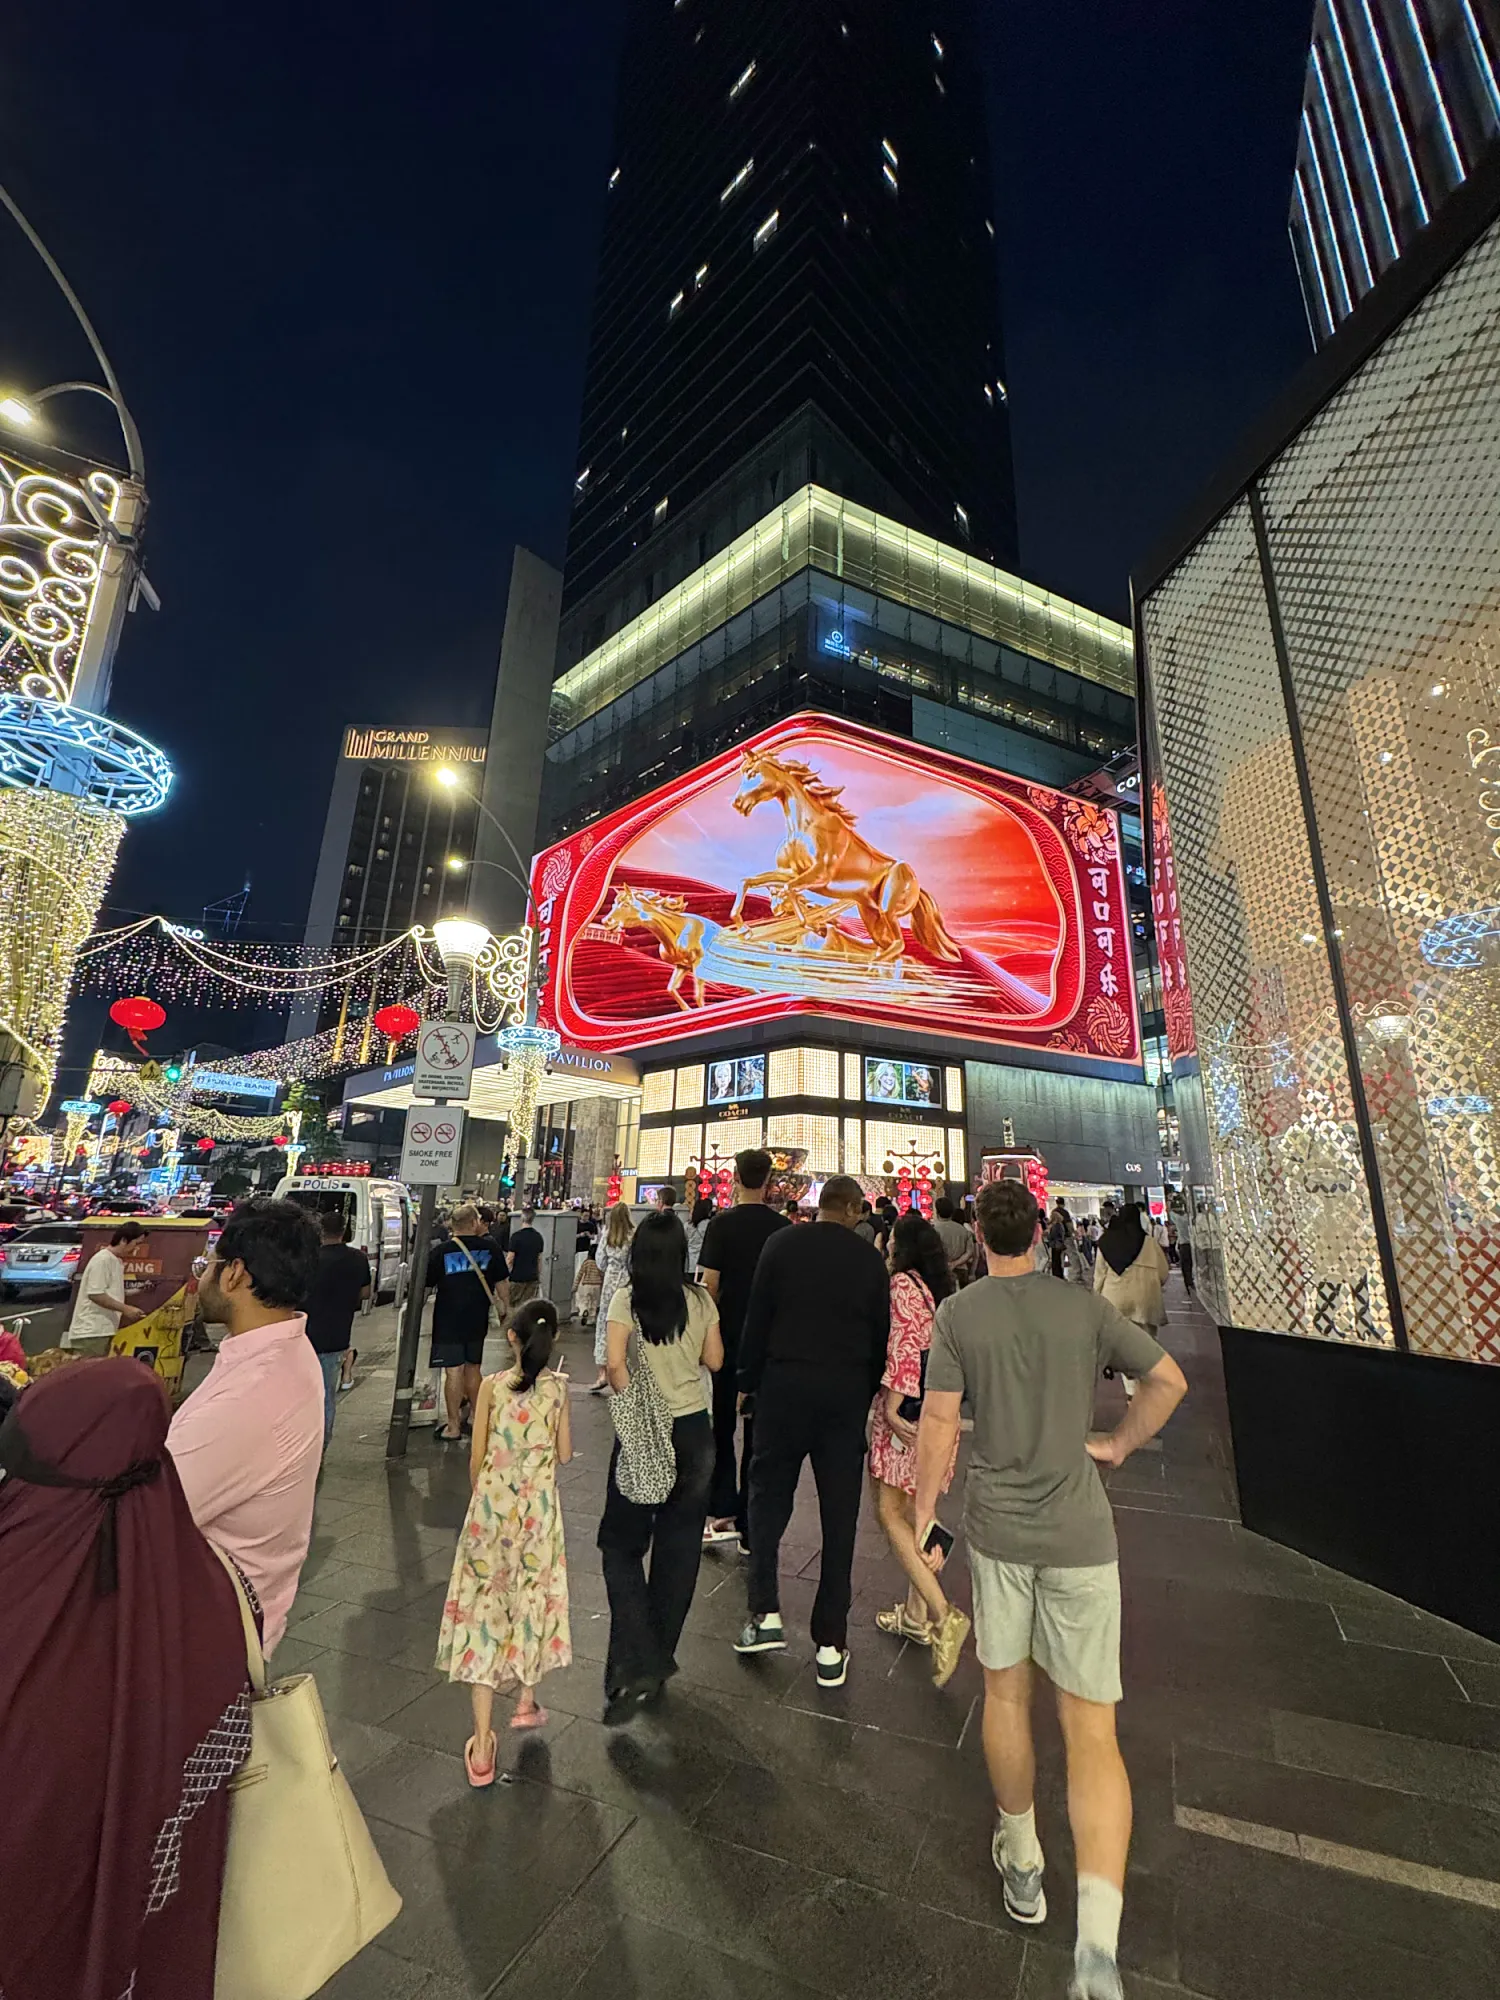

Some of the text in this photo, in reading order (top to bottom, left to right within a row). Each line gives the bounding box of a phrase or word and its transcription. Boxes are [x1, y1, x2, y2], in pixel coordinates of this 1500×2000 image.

[373, 730, 429, 743] GRAND
[371, 744, 486, 762] MILLENNIU
[1087, 868, 1119, 998] 可口可乐
[549, 1052, 612, 1073] PAVILION
[243, 1082, 271, 1091] BANK
[718, 1109, 749, 1119] COACH
[409, 1150, 433, 1158] SMOKE
[303, 1180, 339, 1190] POLIS
